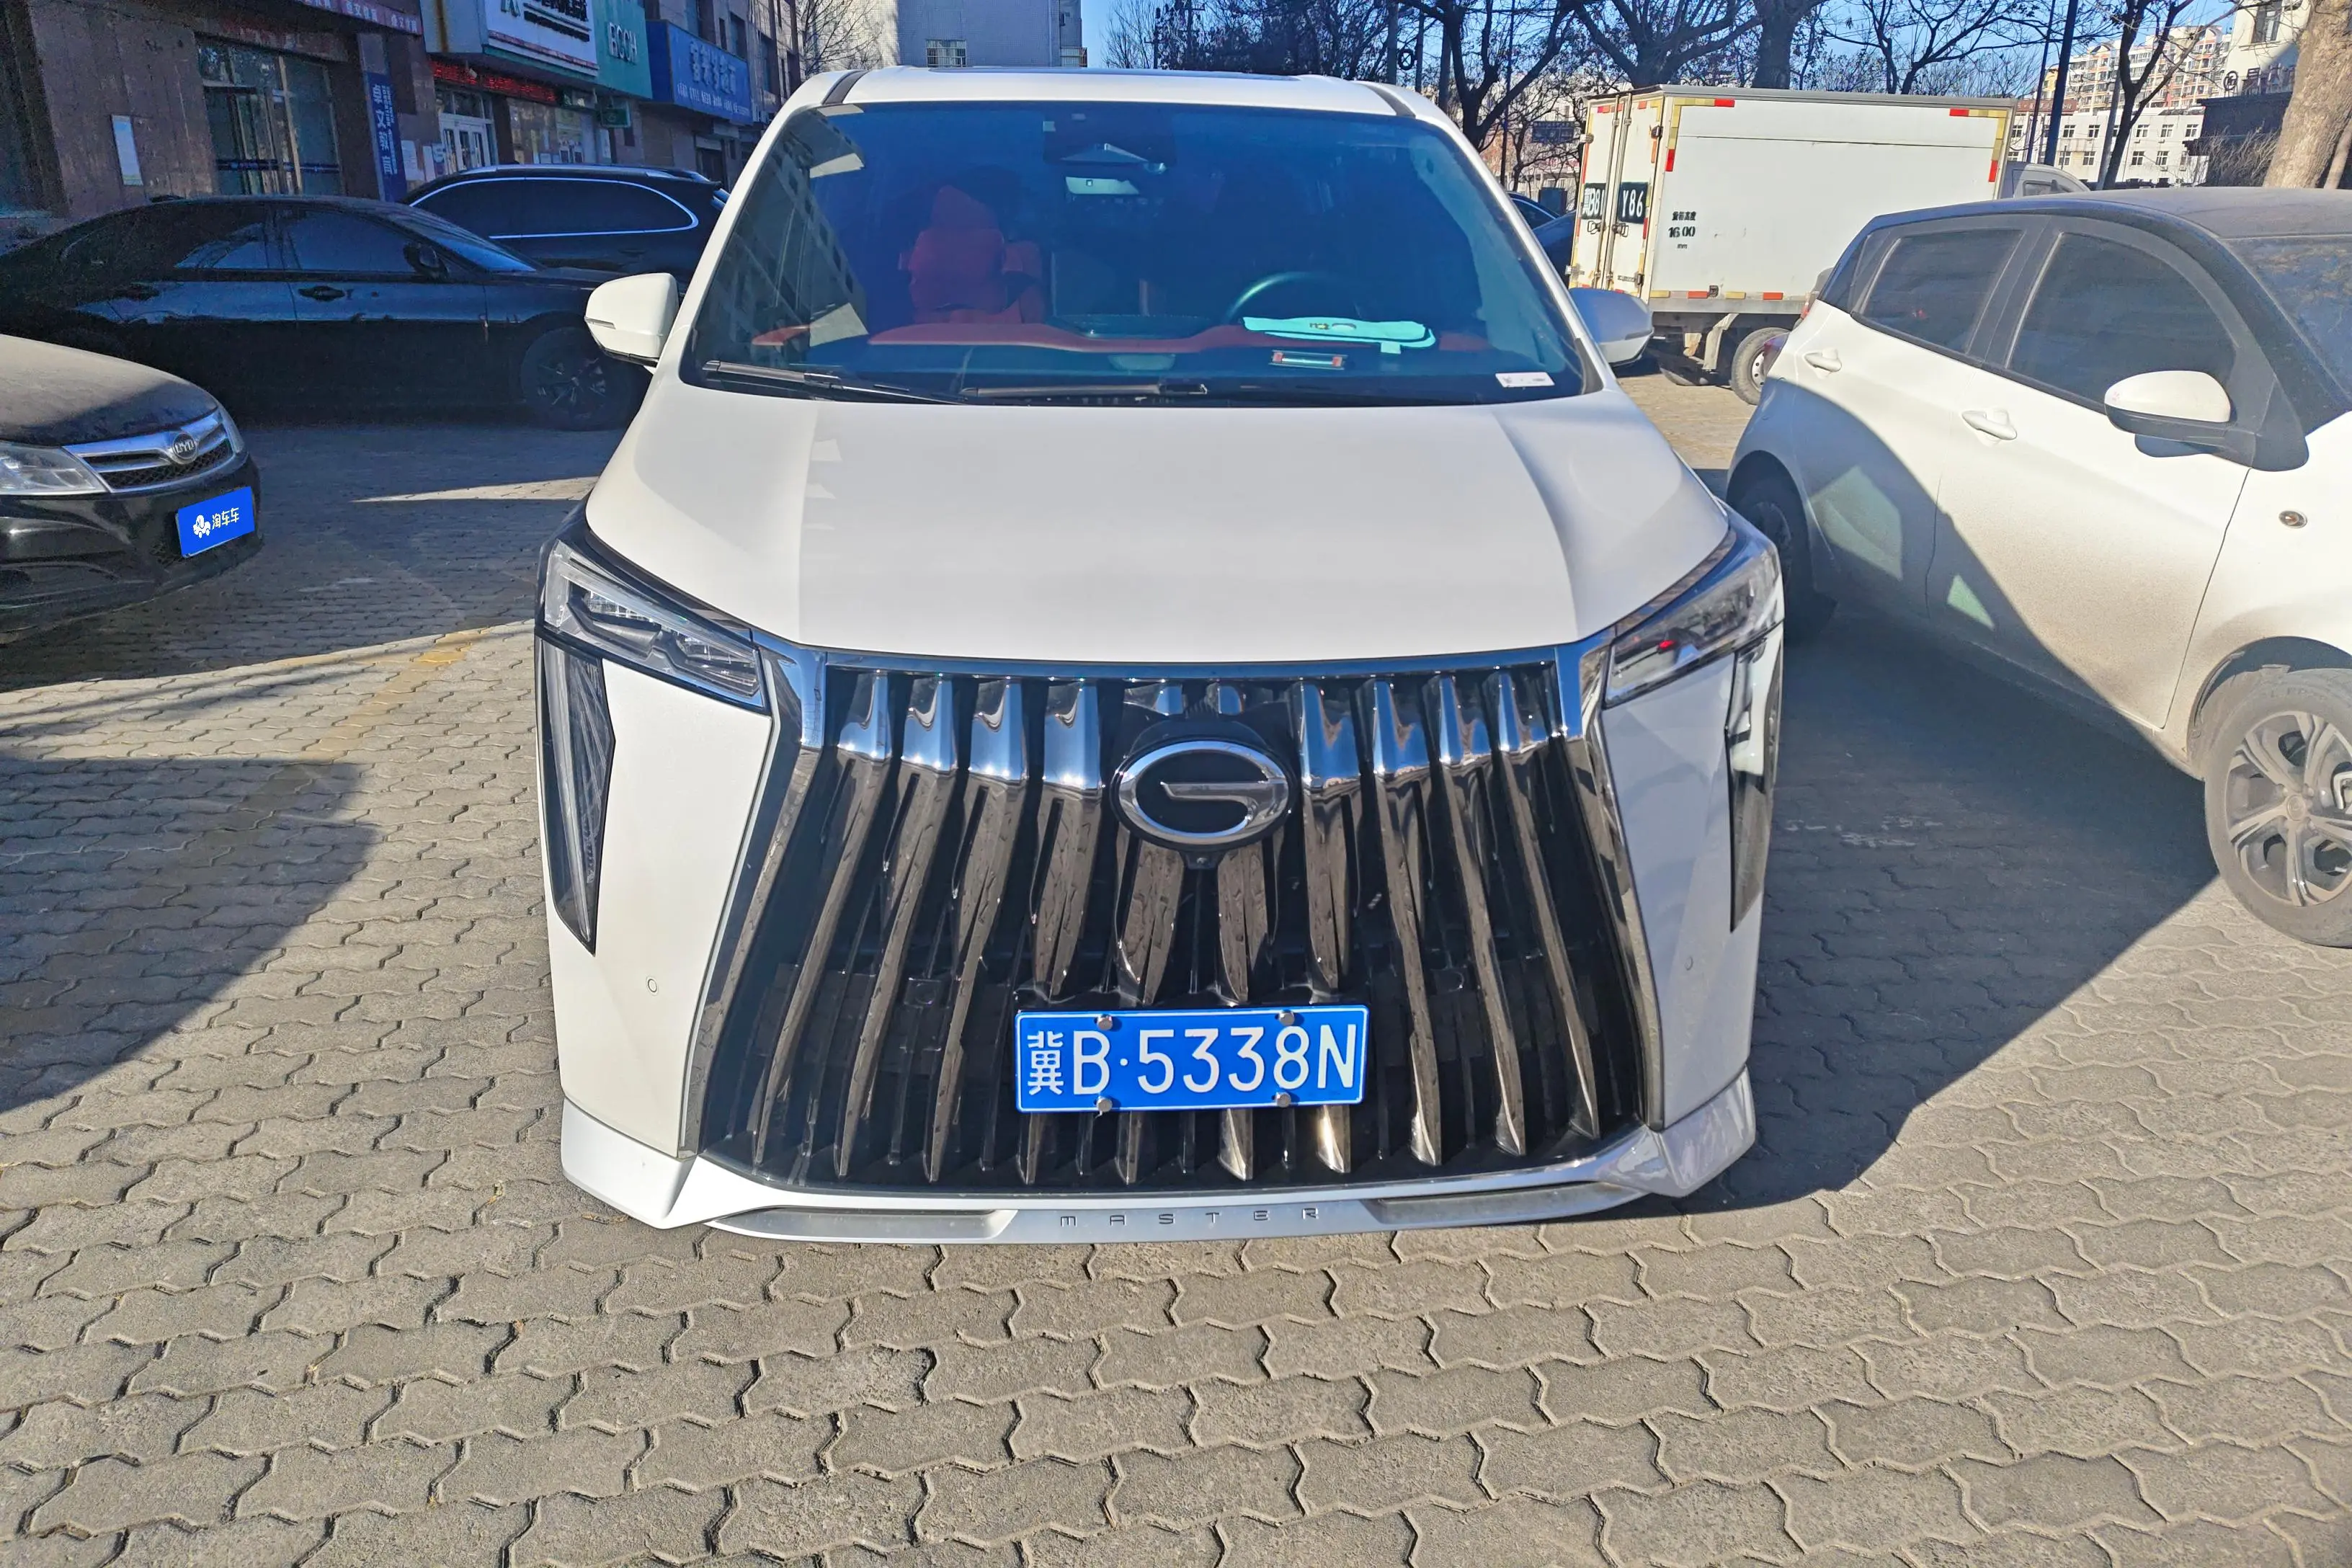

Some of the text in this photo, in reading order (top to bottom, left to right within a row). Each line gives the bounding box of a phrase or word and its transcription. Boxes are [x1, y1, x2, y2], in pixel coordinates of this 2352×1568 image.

[1621, 189, 1644, 218] Y86
[1668, 226, 1696, 238] 1600
[211, 507, 240, 530] 淘车车
[1027, 1024, 1356, 1096] 冀B·5338N
[1060, 1207, 1319, 1226] MASTER
